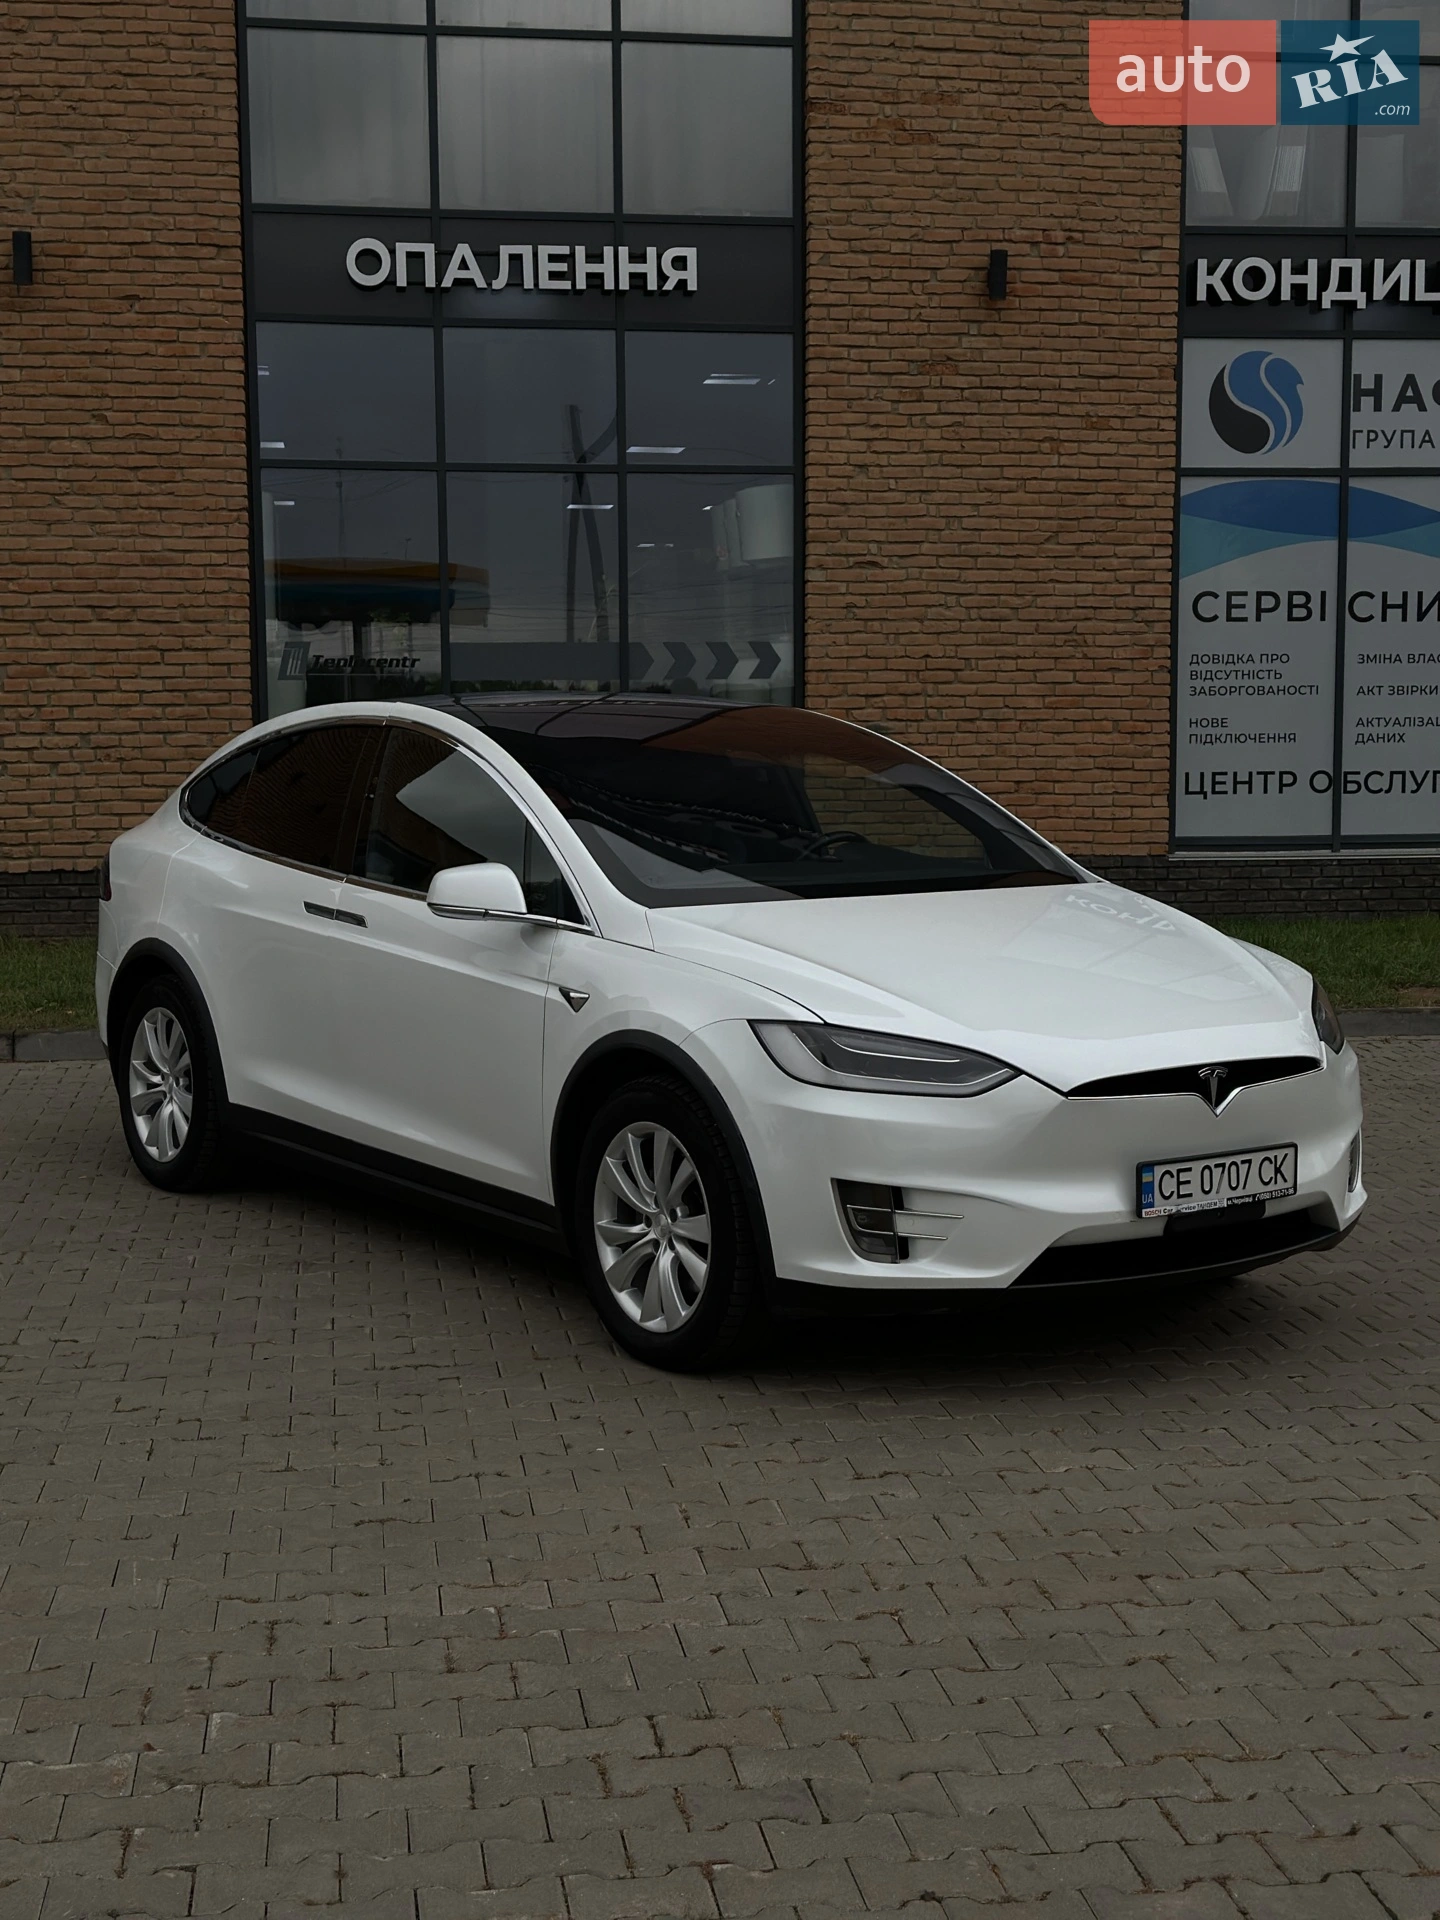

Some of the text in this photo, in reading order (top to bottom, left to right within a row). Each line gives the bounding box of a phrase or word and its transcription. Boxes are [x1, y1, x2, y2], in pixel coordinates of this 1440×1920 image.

[346, 237, 698, 292] ОПАЛЕННЯ
[1352, 373, 1440, 413] НА
[1352, 429, 1436, 450] ГРУПА
[1189, 653, 1291, 667] ДОВІДКА ПРО
[1356, 652, 1440, 665] ЗМІНА ВЛА
[1189, 669, 1283, 683] ВІДСУТНІСТЬ
[1188, 684, 1319, 697] ЗАБОРГОВАНОСТІ
[1356, 684, 1439, 696] АКТ ЗВІРКИ
[1189, 717, 1229, 729] НОВЕ
[1188, 732, 1297, 746] ПІДКЛЮЧЕННЯ
[1354, 732, 1406, 746] ДАНИХ
[1184, 770, 1298, 800] ЦЕНТР
[1158, 1153, 1289, 1200] CE 0707 CK
[1142, 1193, 1154, 1204] UA
